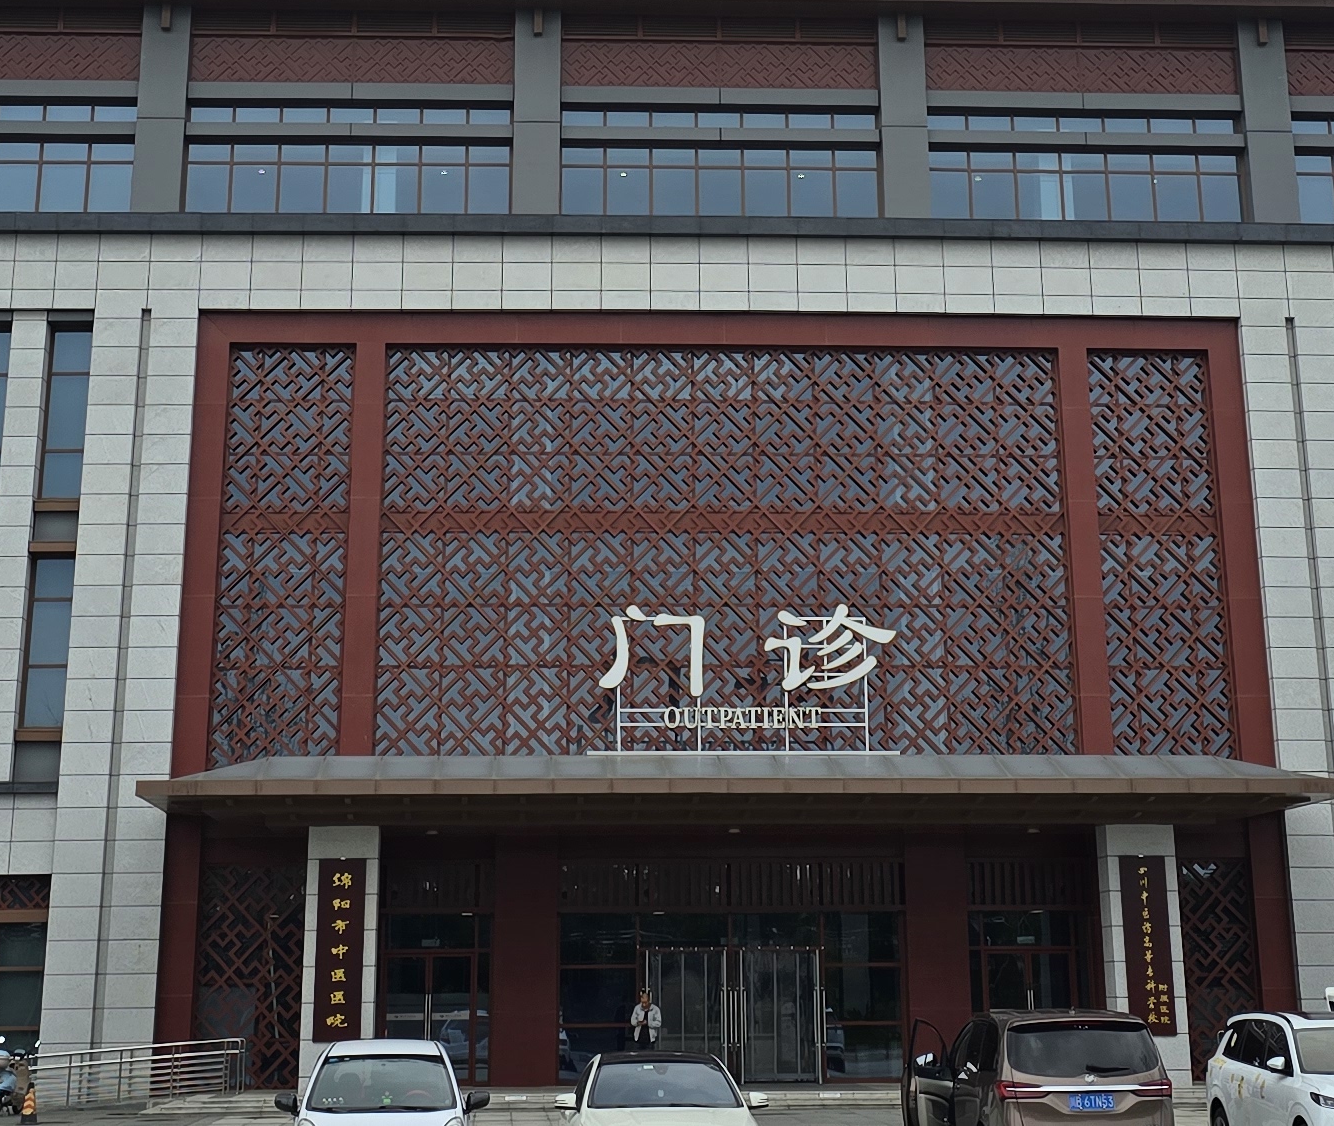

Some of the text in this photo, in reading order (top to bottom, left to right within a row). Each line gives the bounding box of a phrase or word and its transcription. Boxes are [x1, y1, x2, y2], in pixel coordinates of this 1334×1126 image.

[598, 604, 897, 697] 门诊
[664, 706, 822, 729] OUTPATIENT
[326, 872, 352, 1028] 绵阳市中医医院
